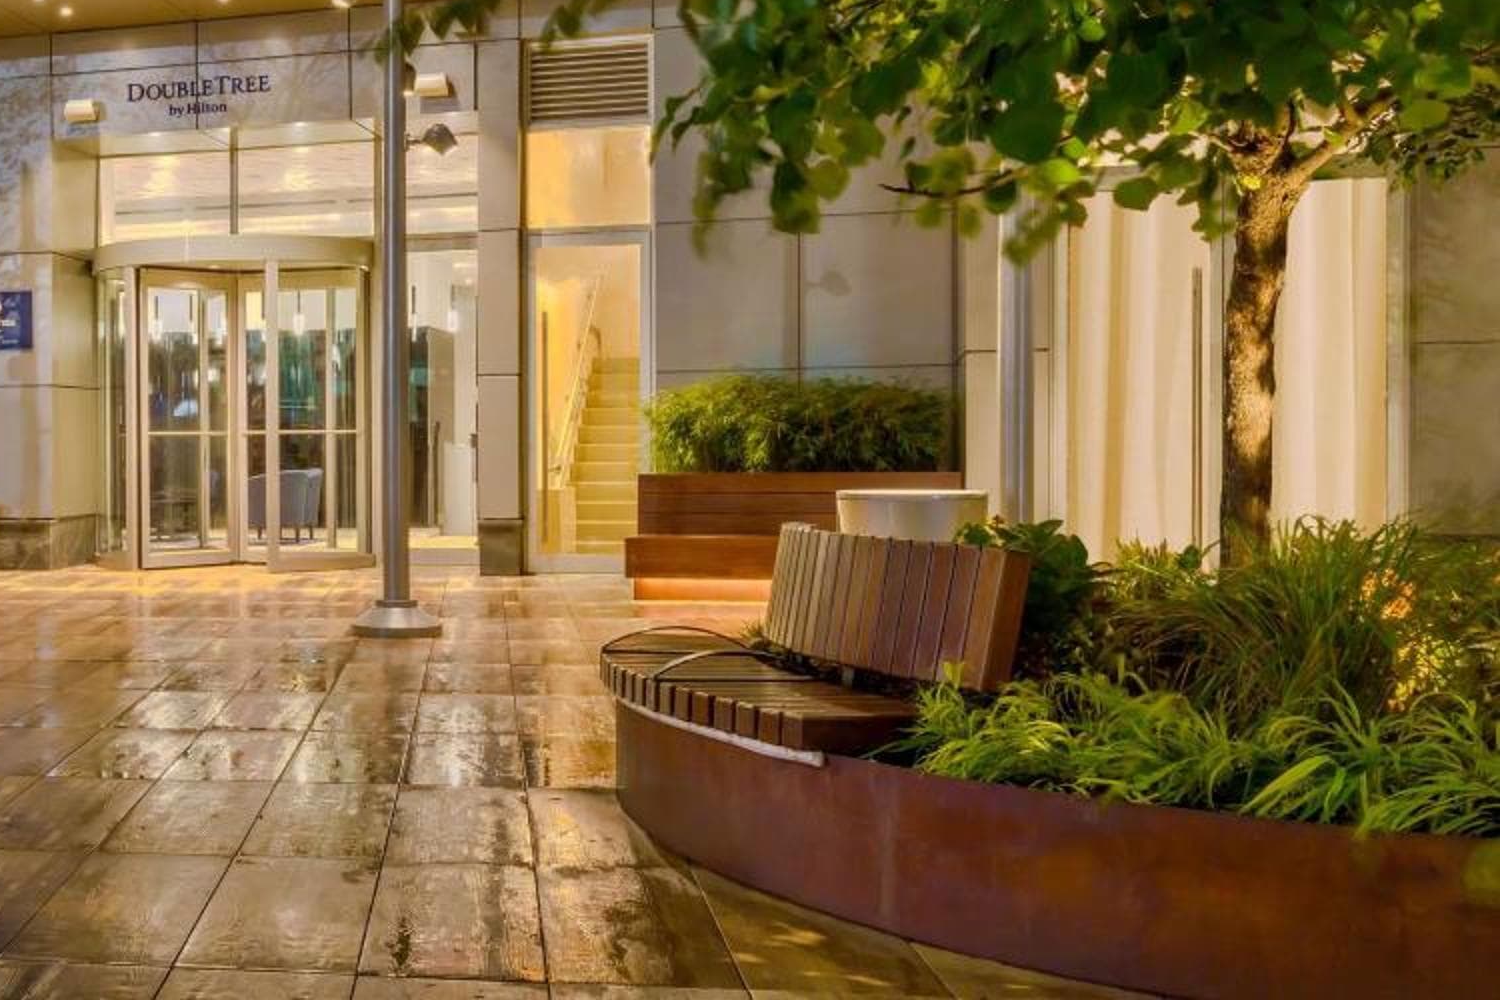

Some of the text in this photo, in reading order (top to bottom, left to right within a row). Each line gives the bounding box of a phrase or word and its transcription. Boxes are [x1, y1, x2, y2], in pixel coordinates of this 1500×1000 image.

[127, 75, 271, 102] DOUBLETREE
[169, 102, 227, 118] by Hilton
